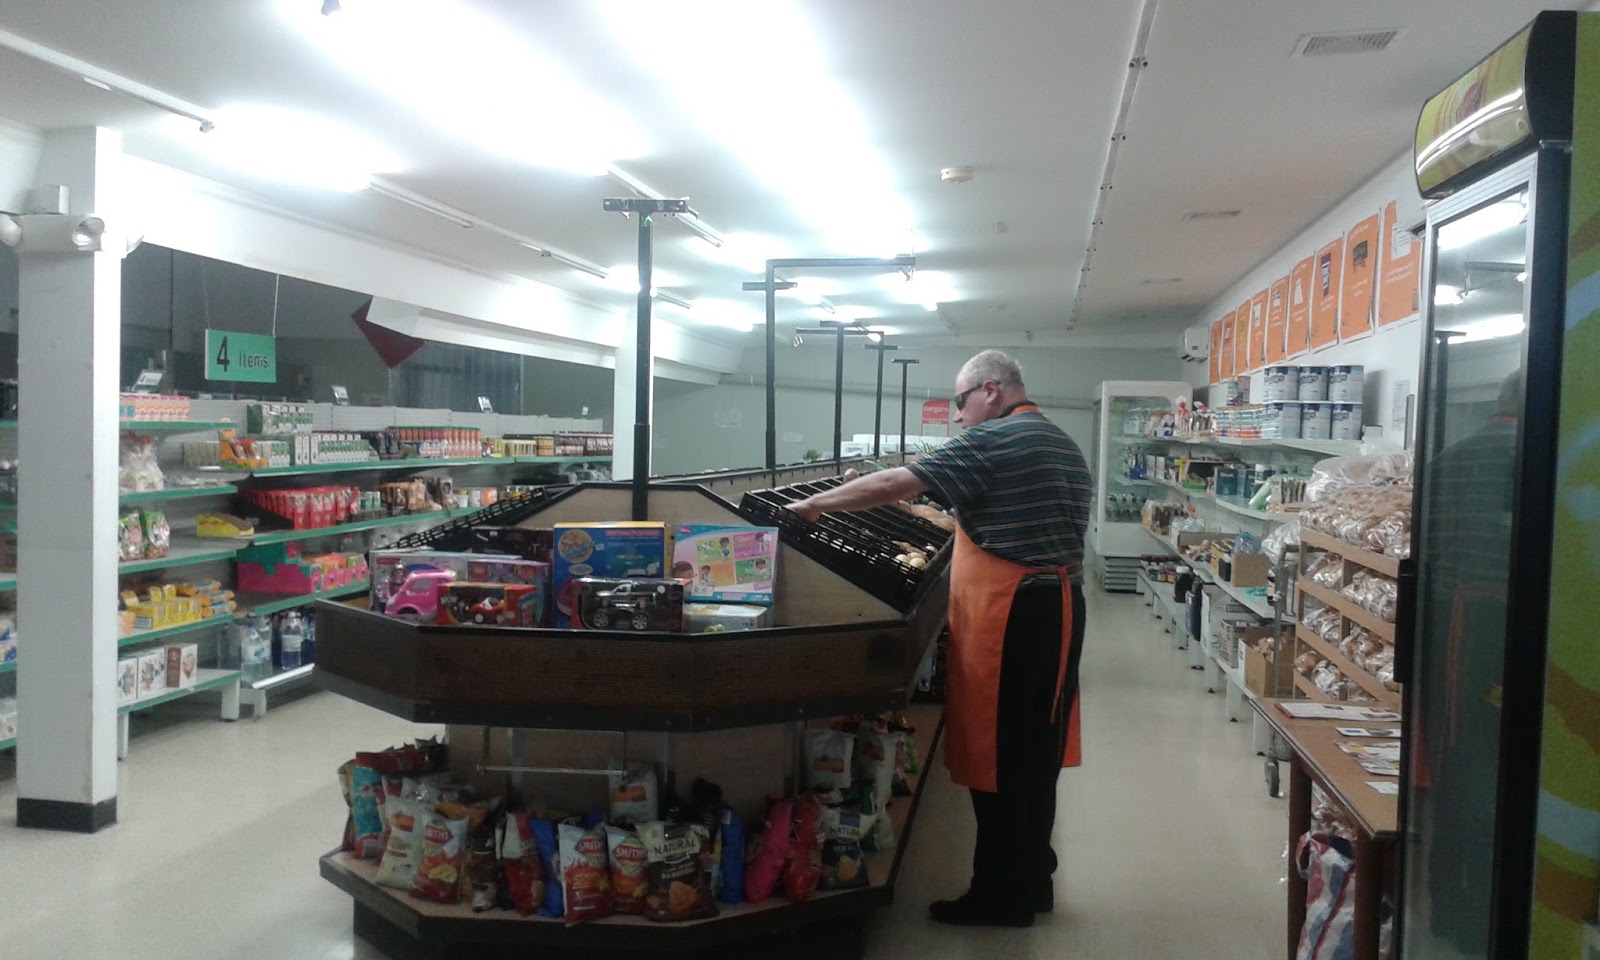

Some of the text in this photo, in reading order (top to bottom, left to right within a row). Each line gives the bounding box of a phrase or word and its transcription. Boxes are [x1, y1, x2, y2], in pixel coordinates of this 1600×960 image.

[217, 336, 268, 372] 4 Items
[654, 838, 697, 856] NATURAL
